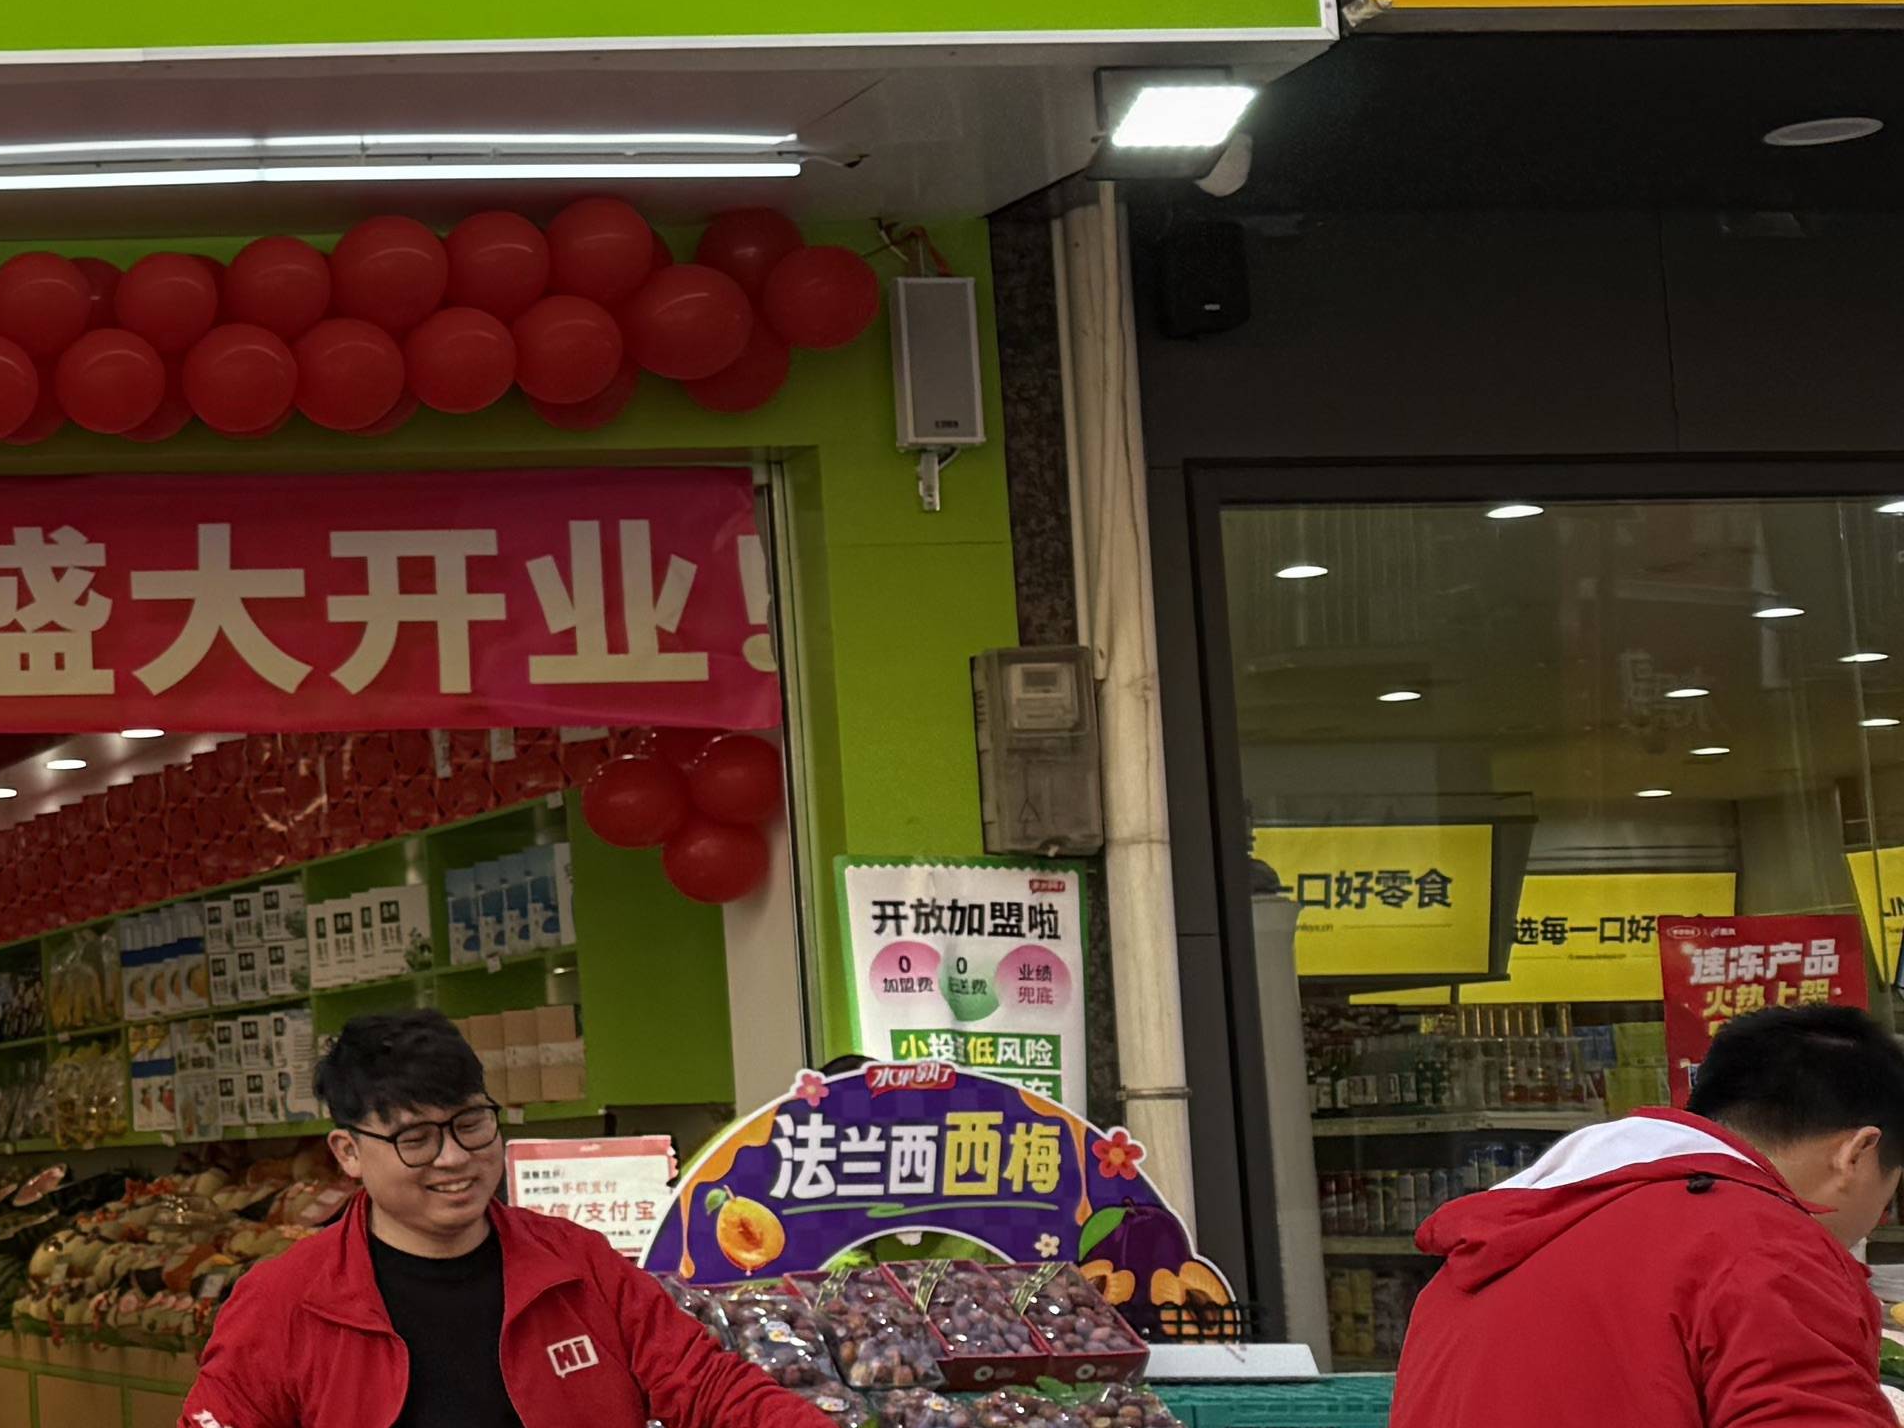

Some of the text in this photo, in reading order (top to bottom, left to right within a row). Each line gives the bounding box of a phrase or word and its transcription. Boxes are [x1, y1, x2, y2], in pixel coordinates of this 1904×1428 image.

[871, 898, 1061, 940] 开放加盟啦
[1018, 963, 1052, 983] 业绩
[1690, 938, 1840, 985] 速冻产品
[1018, 986, 1053, 1005] 兜底
[900, 1032, 1054, 1066] 小投低风险
[769, 1111, 1062, 1199] 法兰西西梅
